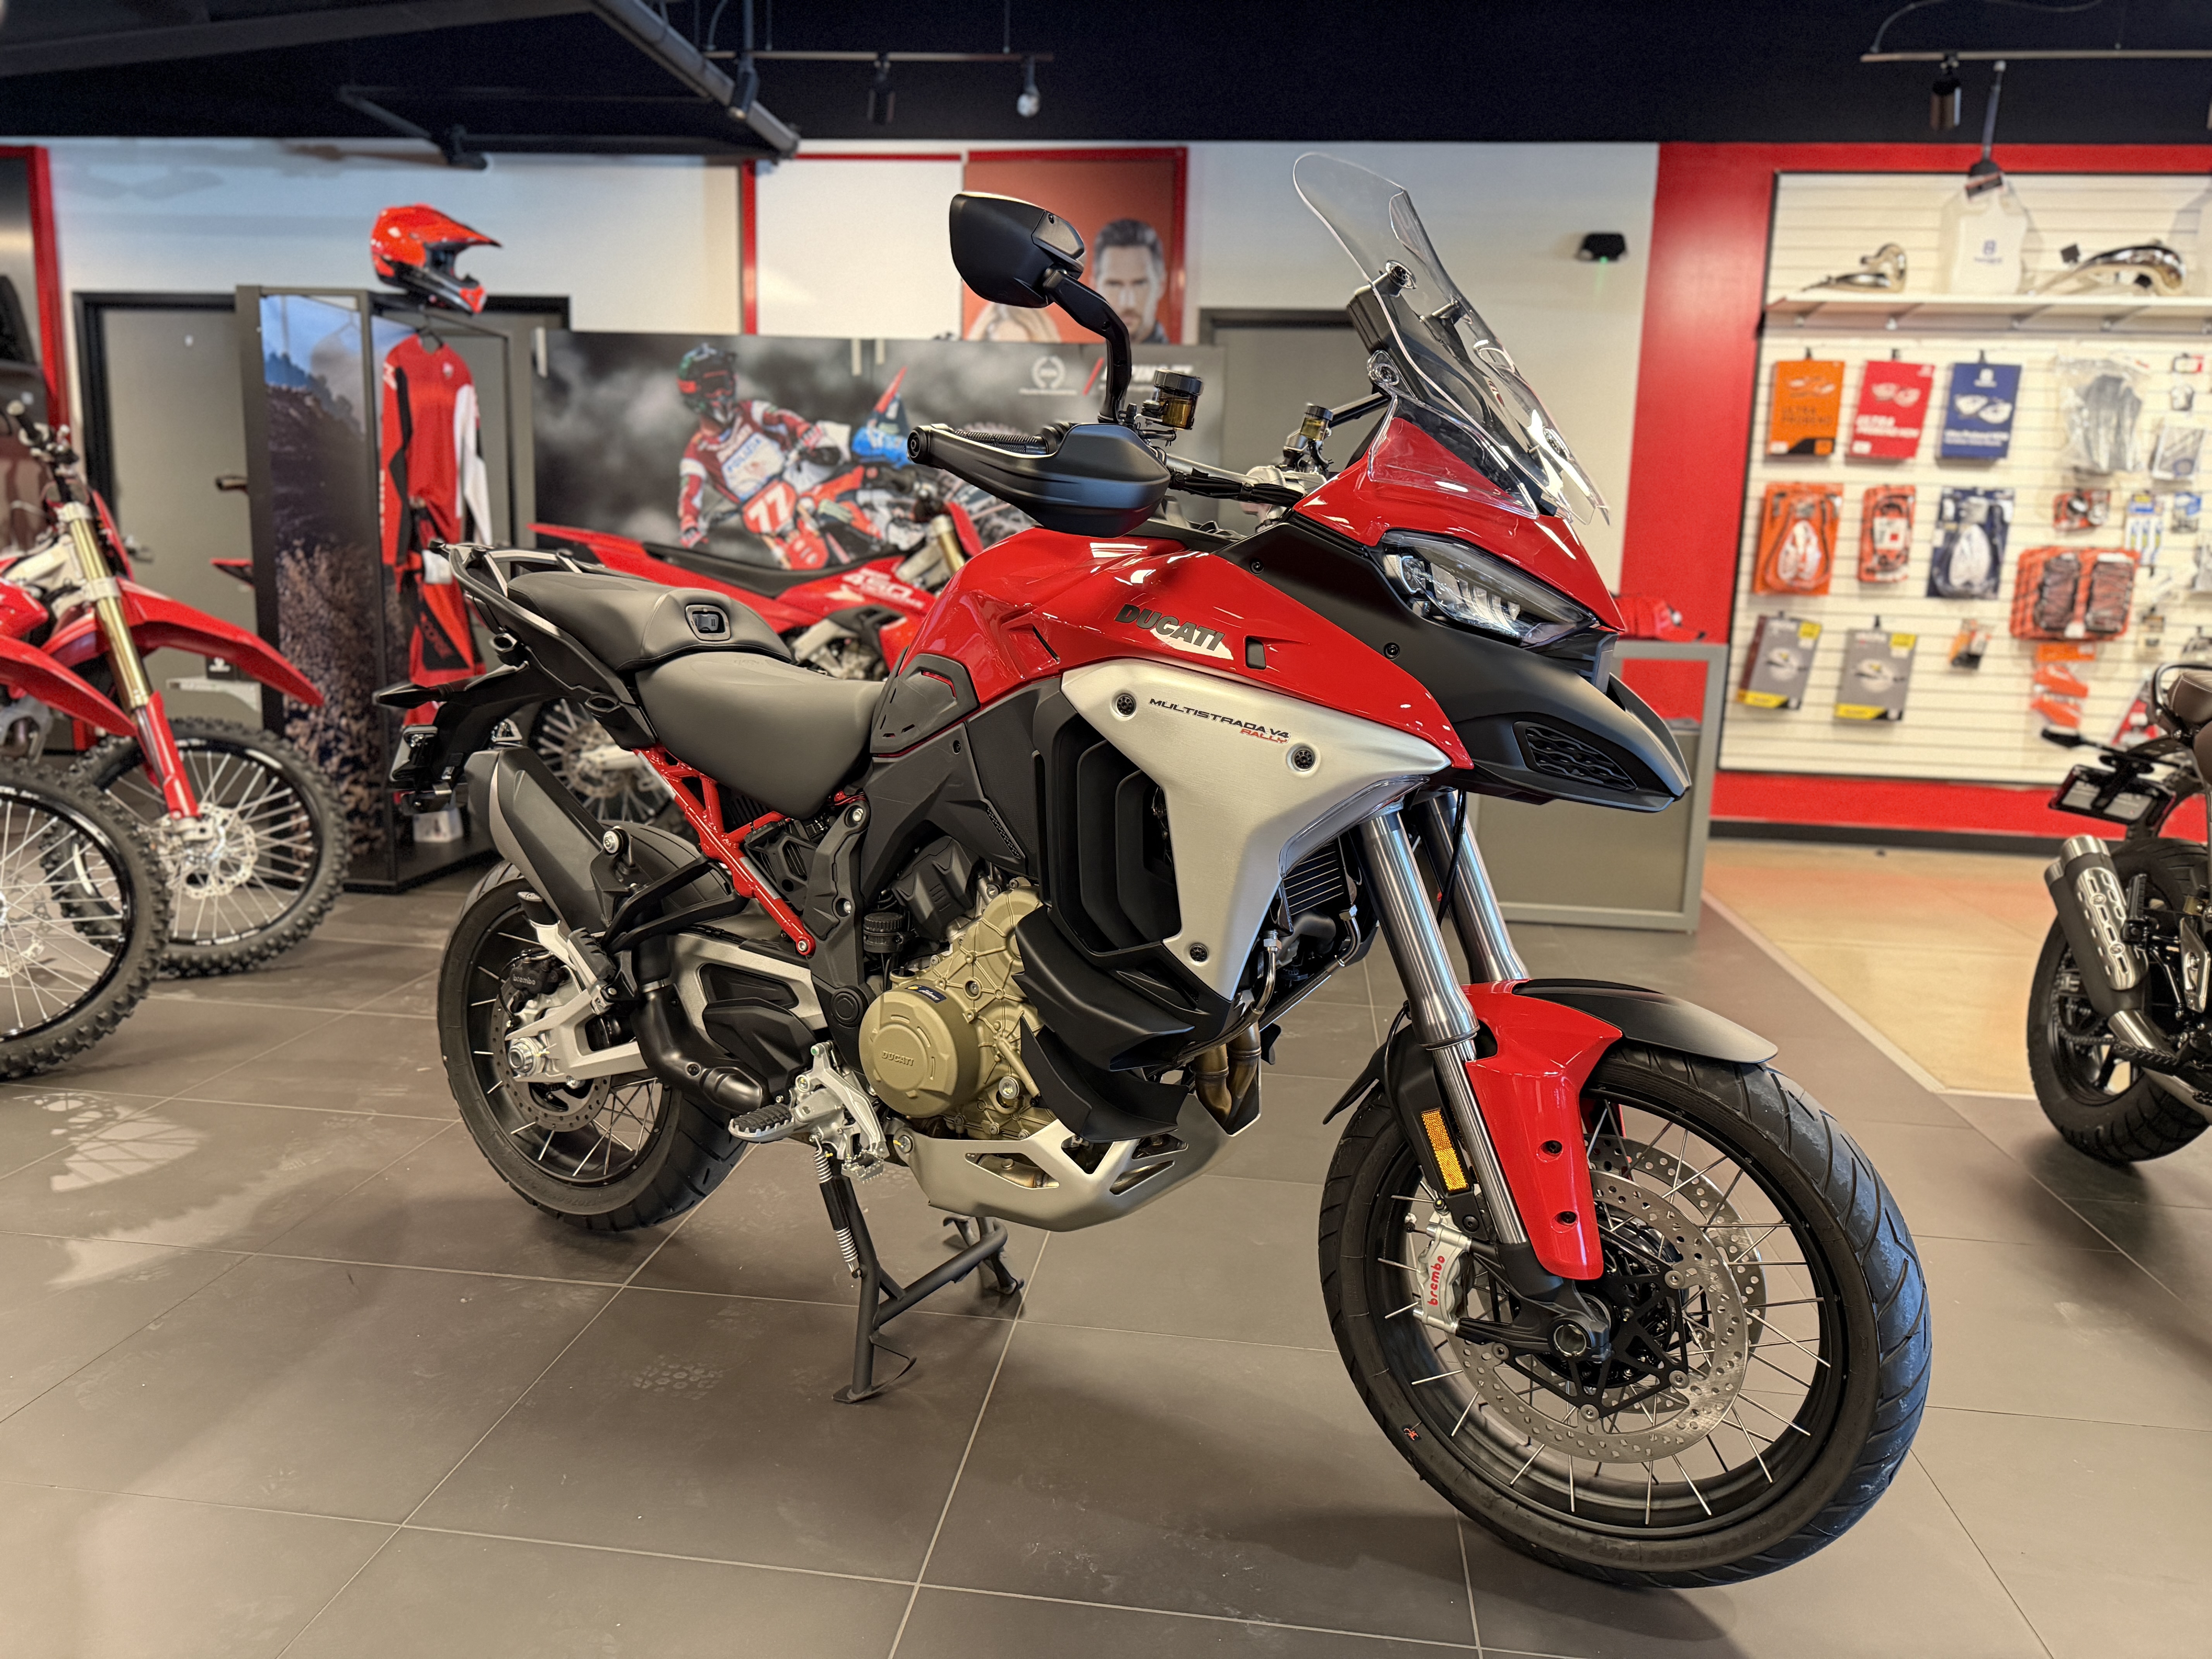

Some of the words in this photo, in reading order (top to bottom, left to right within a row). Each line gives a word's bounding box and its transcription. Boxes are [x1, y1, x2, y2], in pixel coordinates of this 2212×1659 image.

[747, 483, 791, 534] 77
[1114, 603, 1226, 651] DUCATI
[1149, 698, 1266, 733] MULTISTRADA
[1269, 728, 1290, 738] V4
[1240, 728, 1288, 743] RALLY
[513, 974, 536, 985] brembo
[882, 1050, 914, 1066] DUCATI
[1427, 1255, 1445, 1307] brembo
